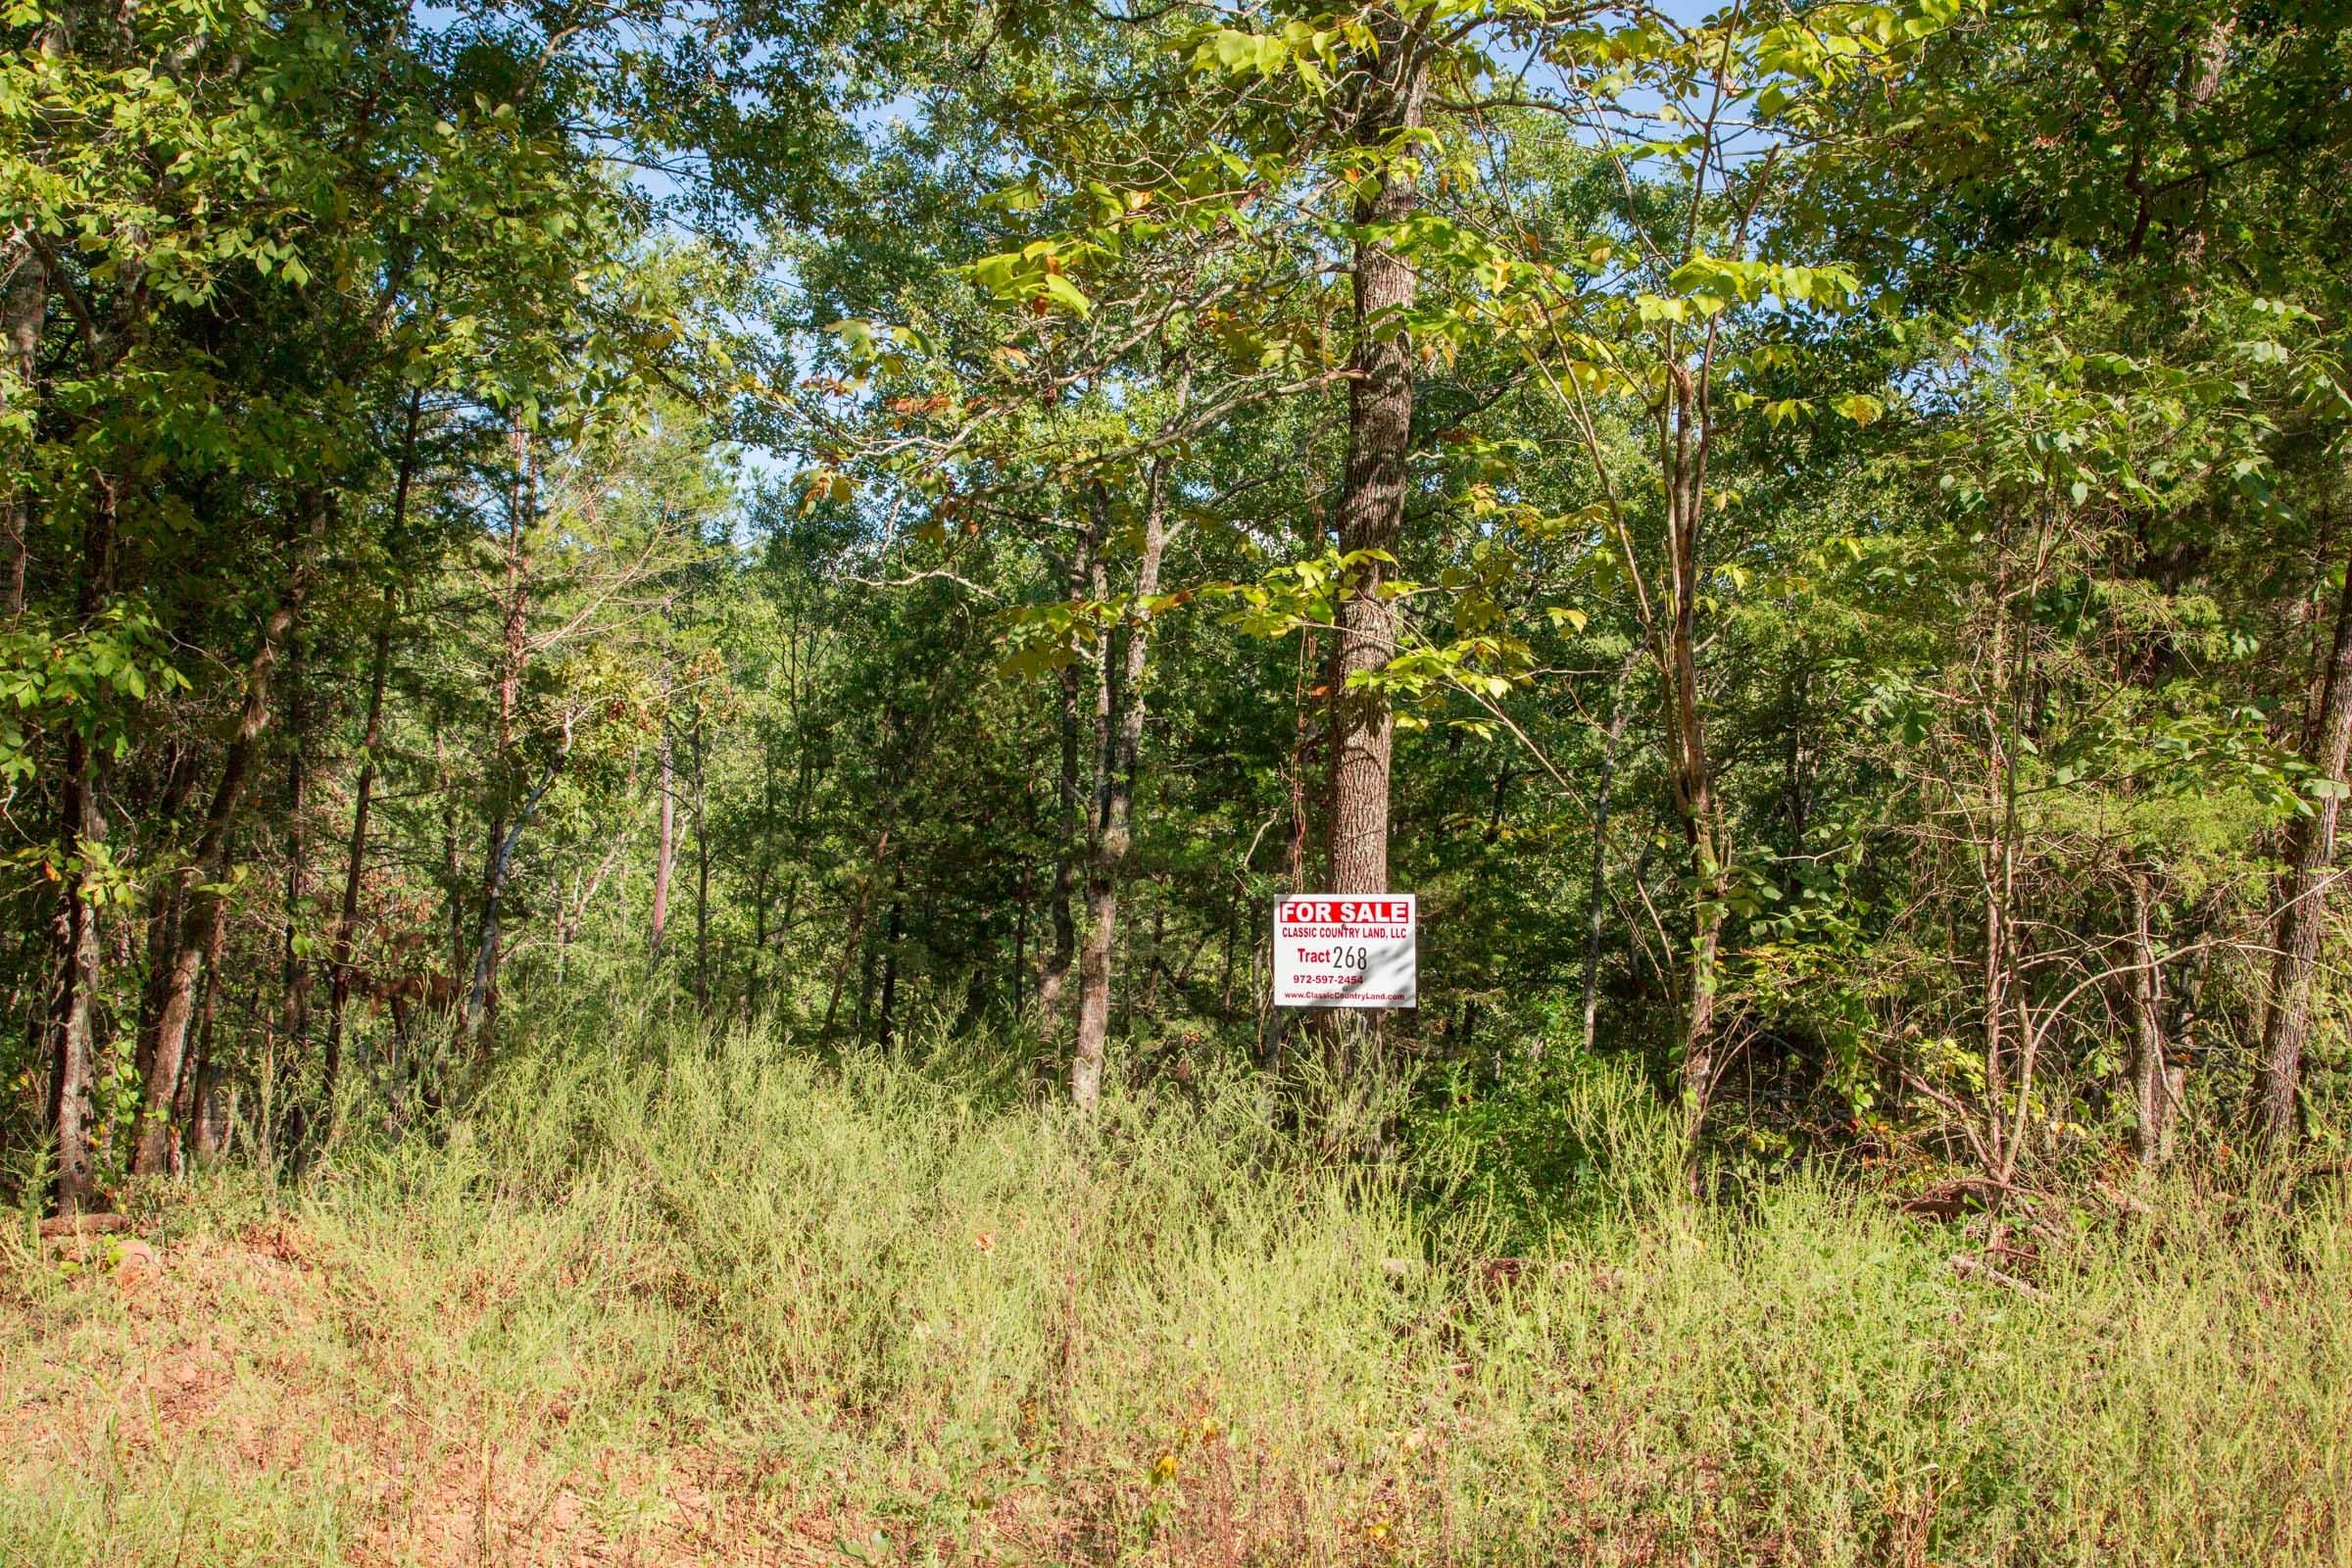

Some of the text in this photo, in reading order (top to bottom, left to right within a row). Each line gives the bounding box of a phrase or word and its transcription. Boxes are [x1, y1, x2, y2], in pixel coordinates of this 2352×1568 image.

[1282, 903, 1407, 922] FOR SALE
[1282, 927, 1317, 938] CLASSIC
[1319, 927, 1360, 939] COUNTRY
[1391, 928, 1407, 939] LLC
[1298, 946, 1367, 970] Tract 268
[1293, 975, 1364, 985] 972-597-2454
[1284, 992, 1405, 1001] www.ClassicCountryLand.com
